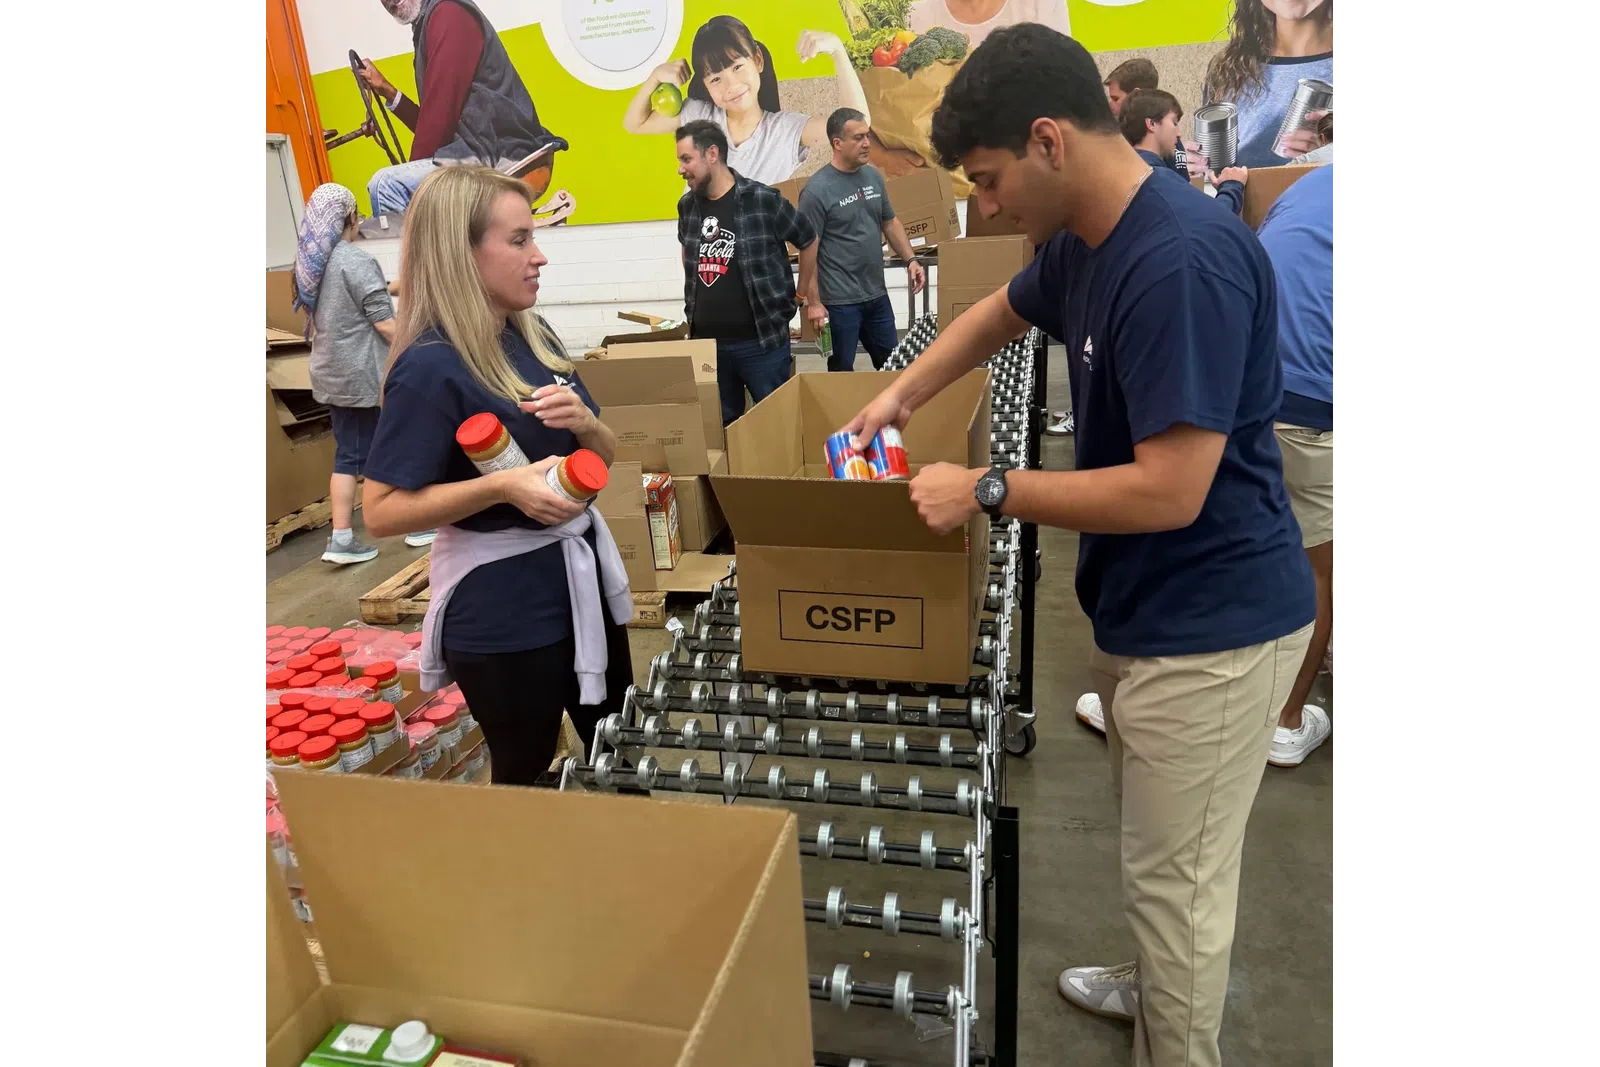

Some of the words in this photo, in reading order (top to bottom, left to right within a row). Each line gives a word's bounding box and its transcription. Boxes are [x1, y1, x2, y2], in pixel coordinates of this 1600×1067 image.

[618, 10, 644, 18] distribute
[585, 23, 608, 31] donated
[839, 193, 859, 208] NAOU
[905, 223, 928, 236] CSFP
[805, 604, 896, 633] CSFP
